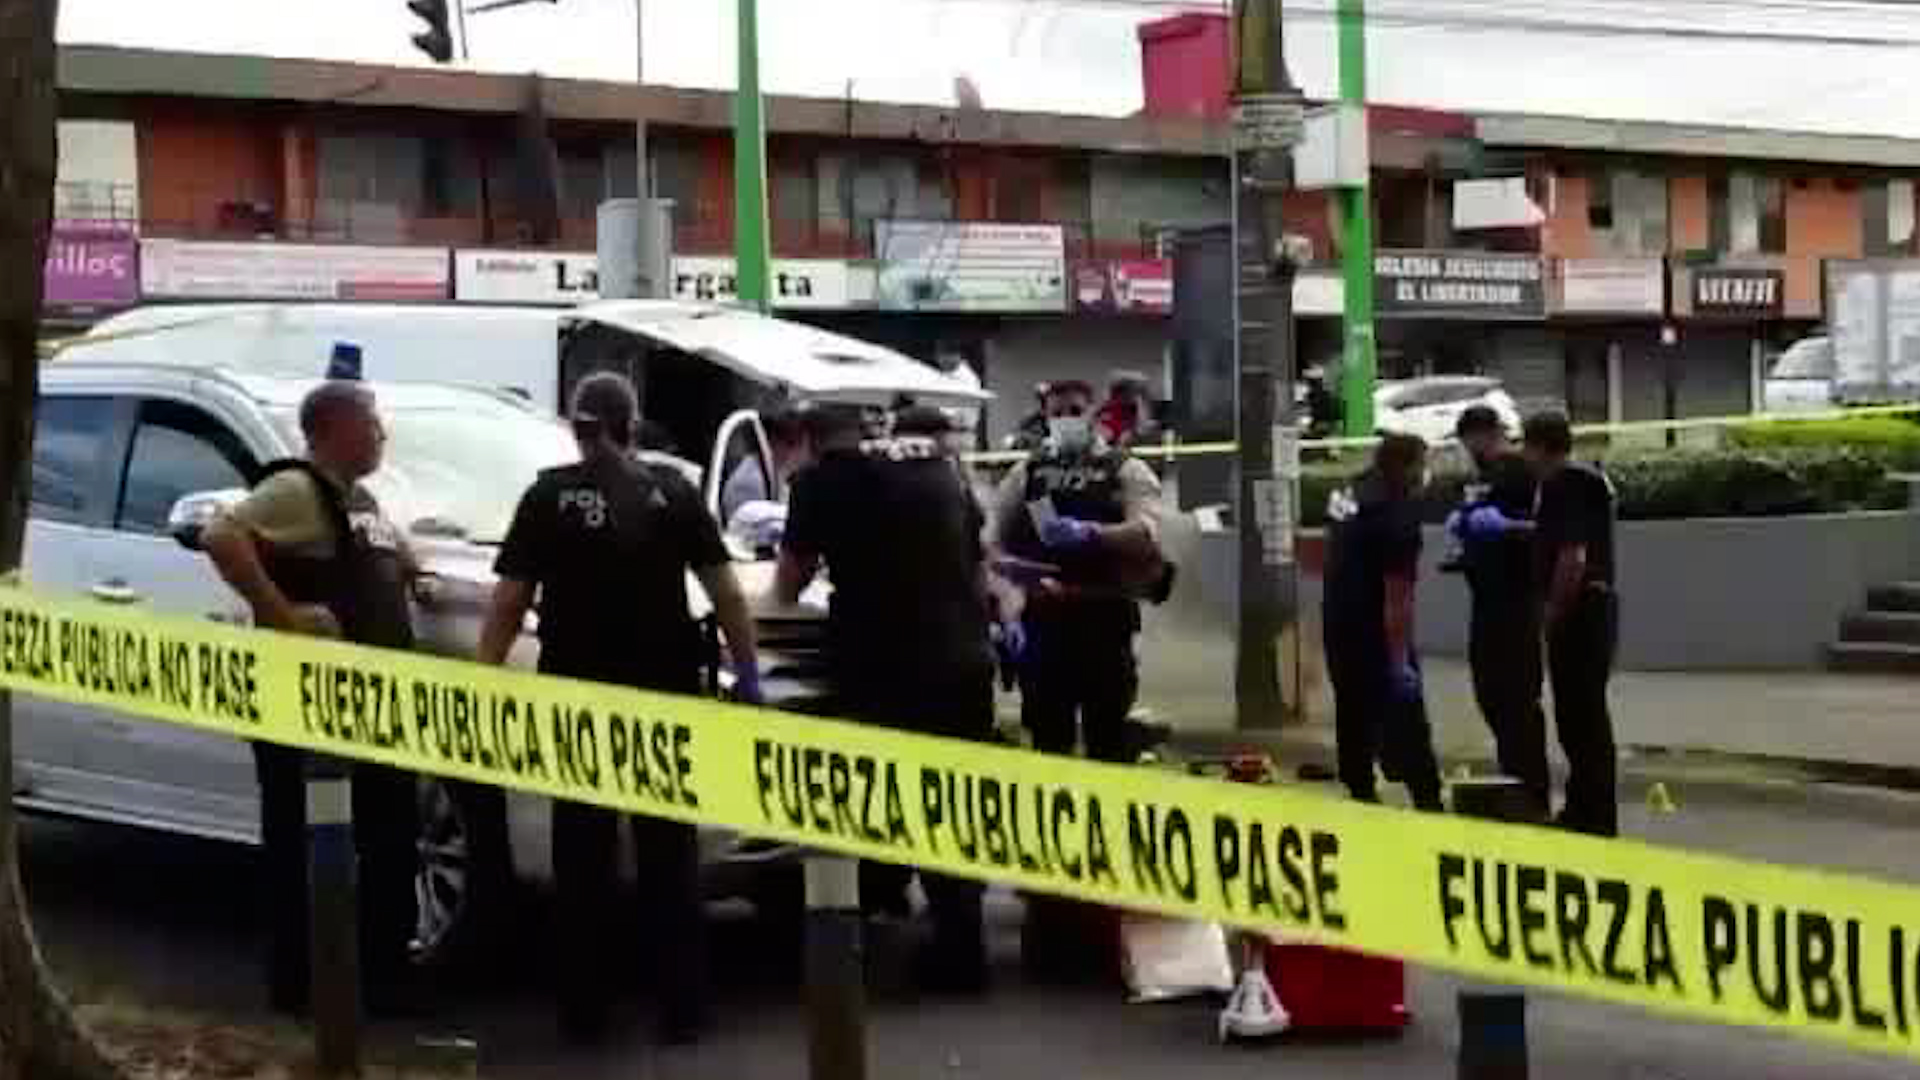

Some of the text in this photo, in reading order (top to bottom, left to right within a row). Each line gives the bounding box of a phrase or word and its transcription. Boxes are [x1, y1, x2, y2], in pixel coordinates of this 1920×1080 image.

[556, 260, 598, 291] La
[1397, 279, 1521, 303] EL LIBERTADOR
[60, 620, 153, 696] PUBLICA
[157, 635, 193, 710] NO
[196, 641, 261, 723] PASE
[300, 662, 699, 806] FUERZA PUBLICA NO PASE
[753, 739, 1345, 929] FUERZA PUBLICA NO PASE
[1438, 853, 1920, 1035] FUERZA PUBLI
